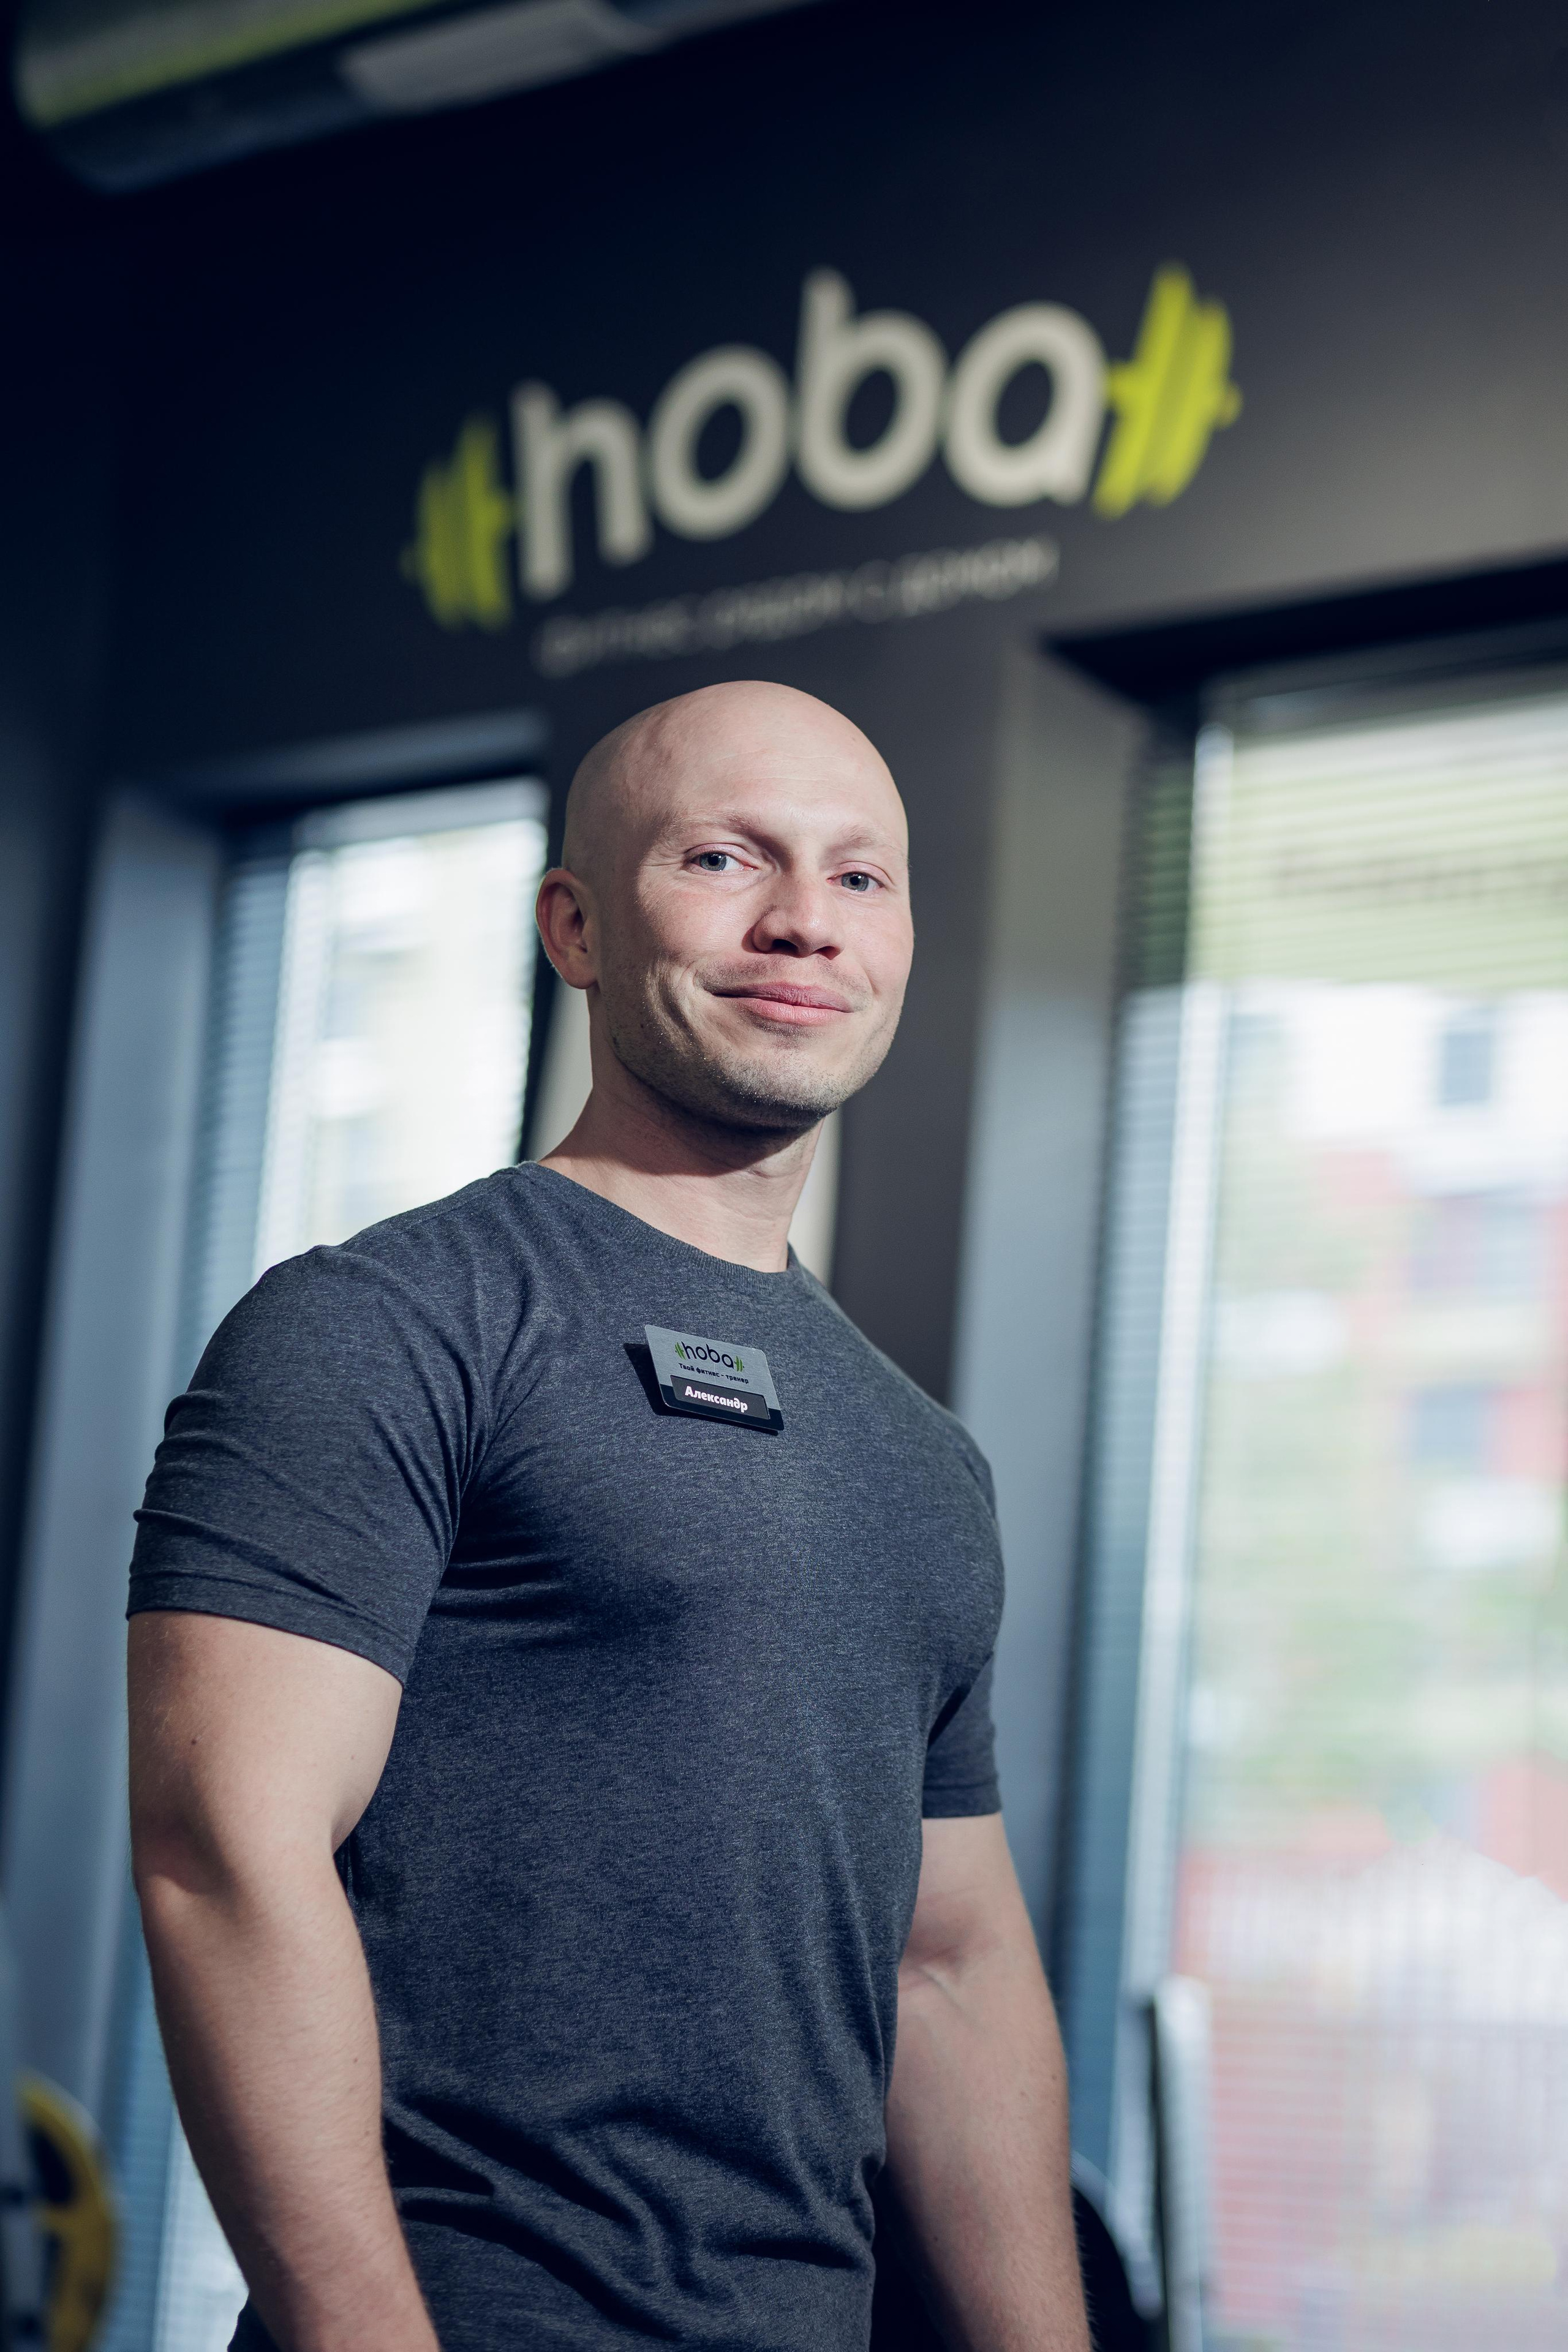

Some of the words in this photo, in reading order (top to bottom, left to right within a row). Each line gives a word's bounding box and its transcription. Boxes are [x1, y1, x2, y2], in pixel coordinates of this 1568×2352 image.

[679, 1363, 695, 1372] Твой
[696, 1366, 720, 1378] фитнес
[725, 1374, 749, 1384] тренер
[685, 1385, 748, 1413] Александр
